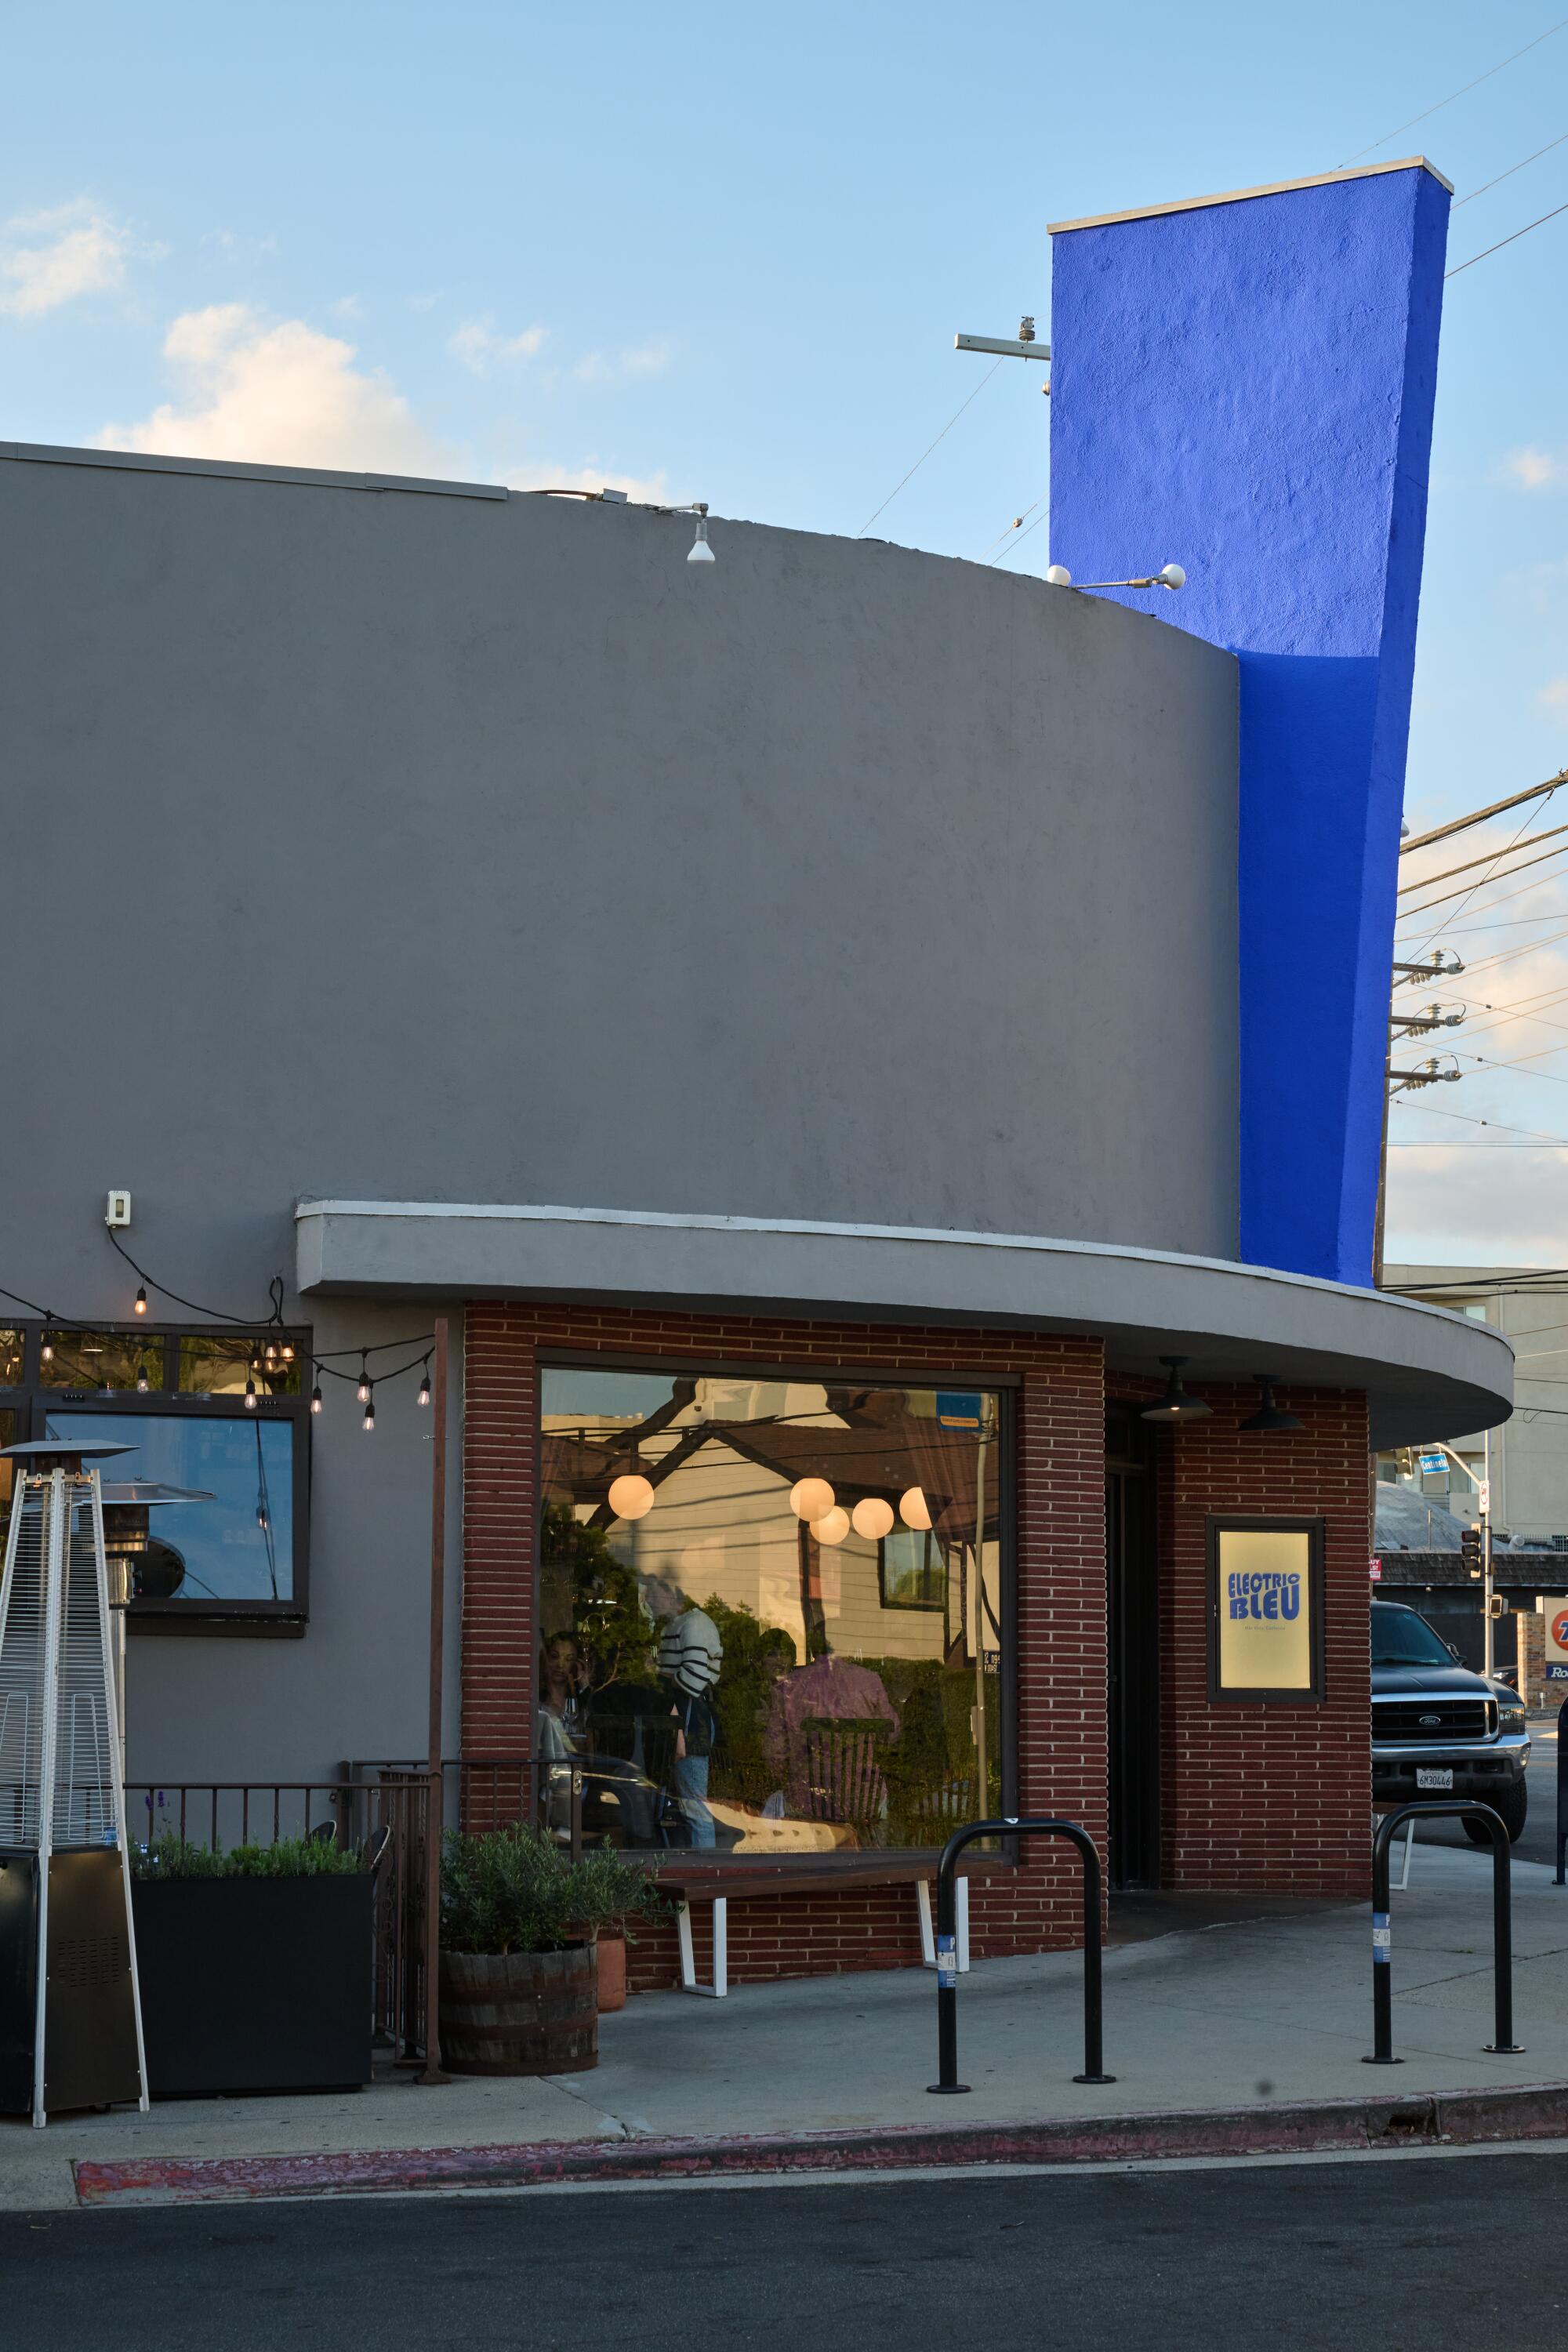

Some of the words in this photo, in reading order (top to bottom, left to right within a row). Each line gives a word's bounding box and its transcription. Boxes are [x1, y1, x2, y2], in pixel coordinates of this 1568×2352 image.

[1421, 1458, 1447, 1470] Centinela
[1228, 1572, 1301, 1599] ELECTRIC
[1229, 1582, 1300, 1621] BLEU
[1551, 1667, 1568, 1678] Ro
